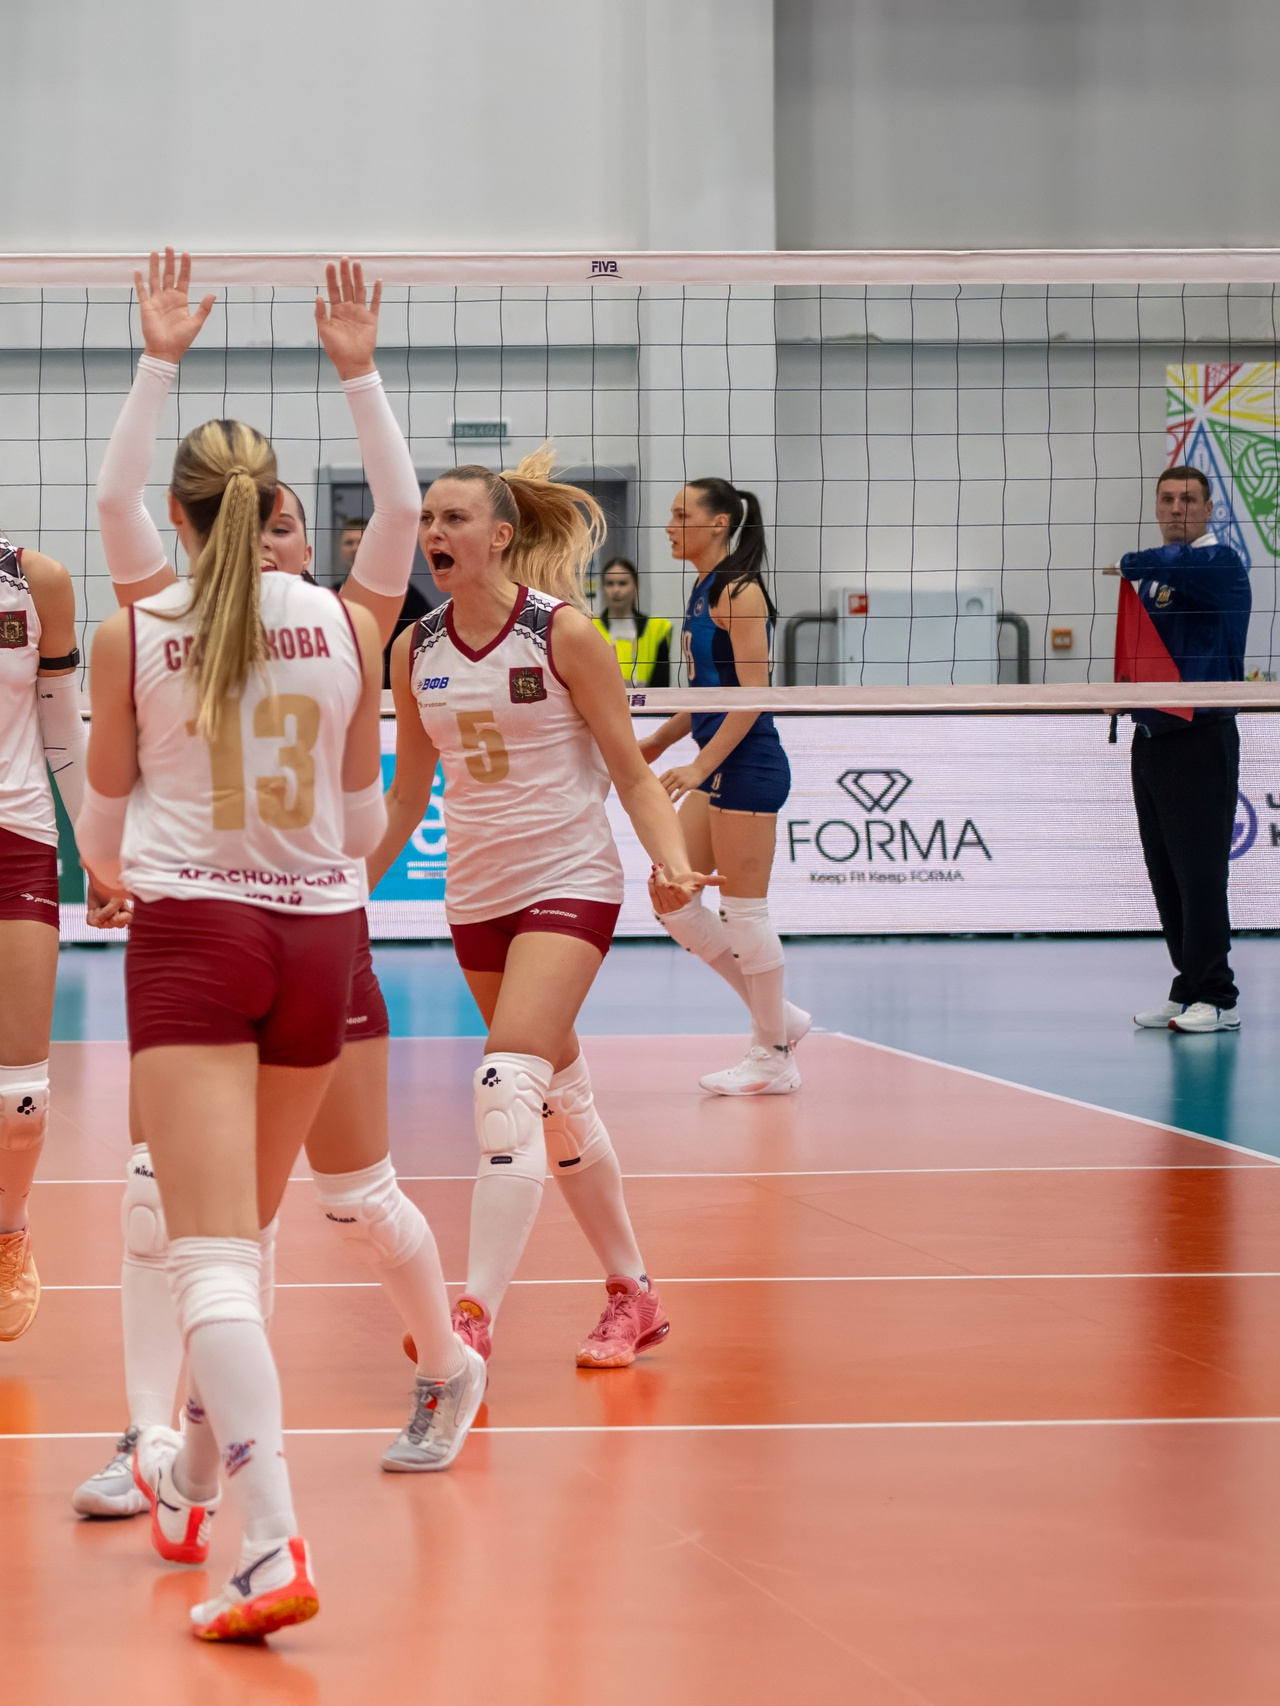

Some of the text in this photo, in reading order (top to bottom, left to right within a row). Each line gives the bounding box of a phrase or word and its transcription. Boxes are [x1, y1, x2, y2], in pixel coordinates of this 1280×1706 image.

[591, 260, 618, 273] FIVB
[421, 676, 450, 691] ВФВ
[455, 709, 510, 784] 5
[185, 693, 321, 831] 13
[788, 818, 993, 863] FORMA
[809, 869, 964, 884] Keep Fit Keep FORMA
